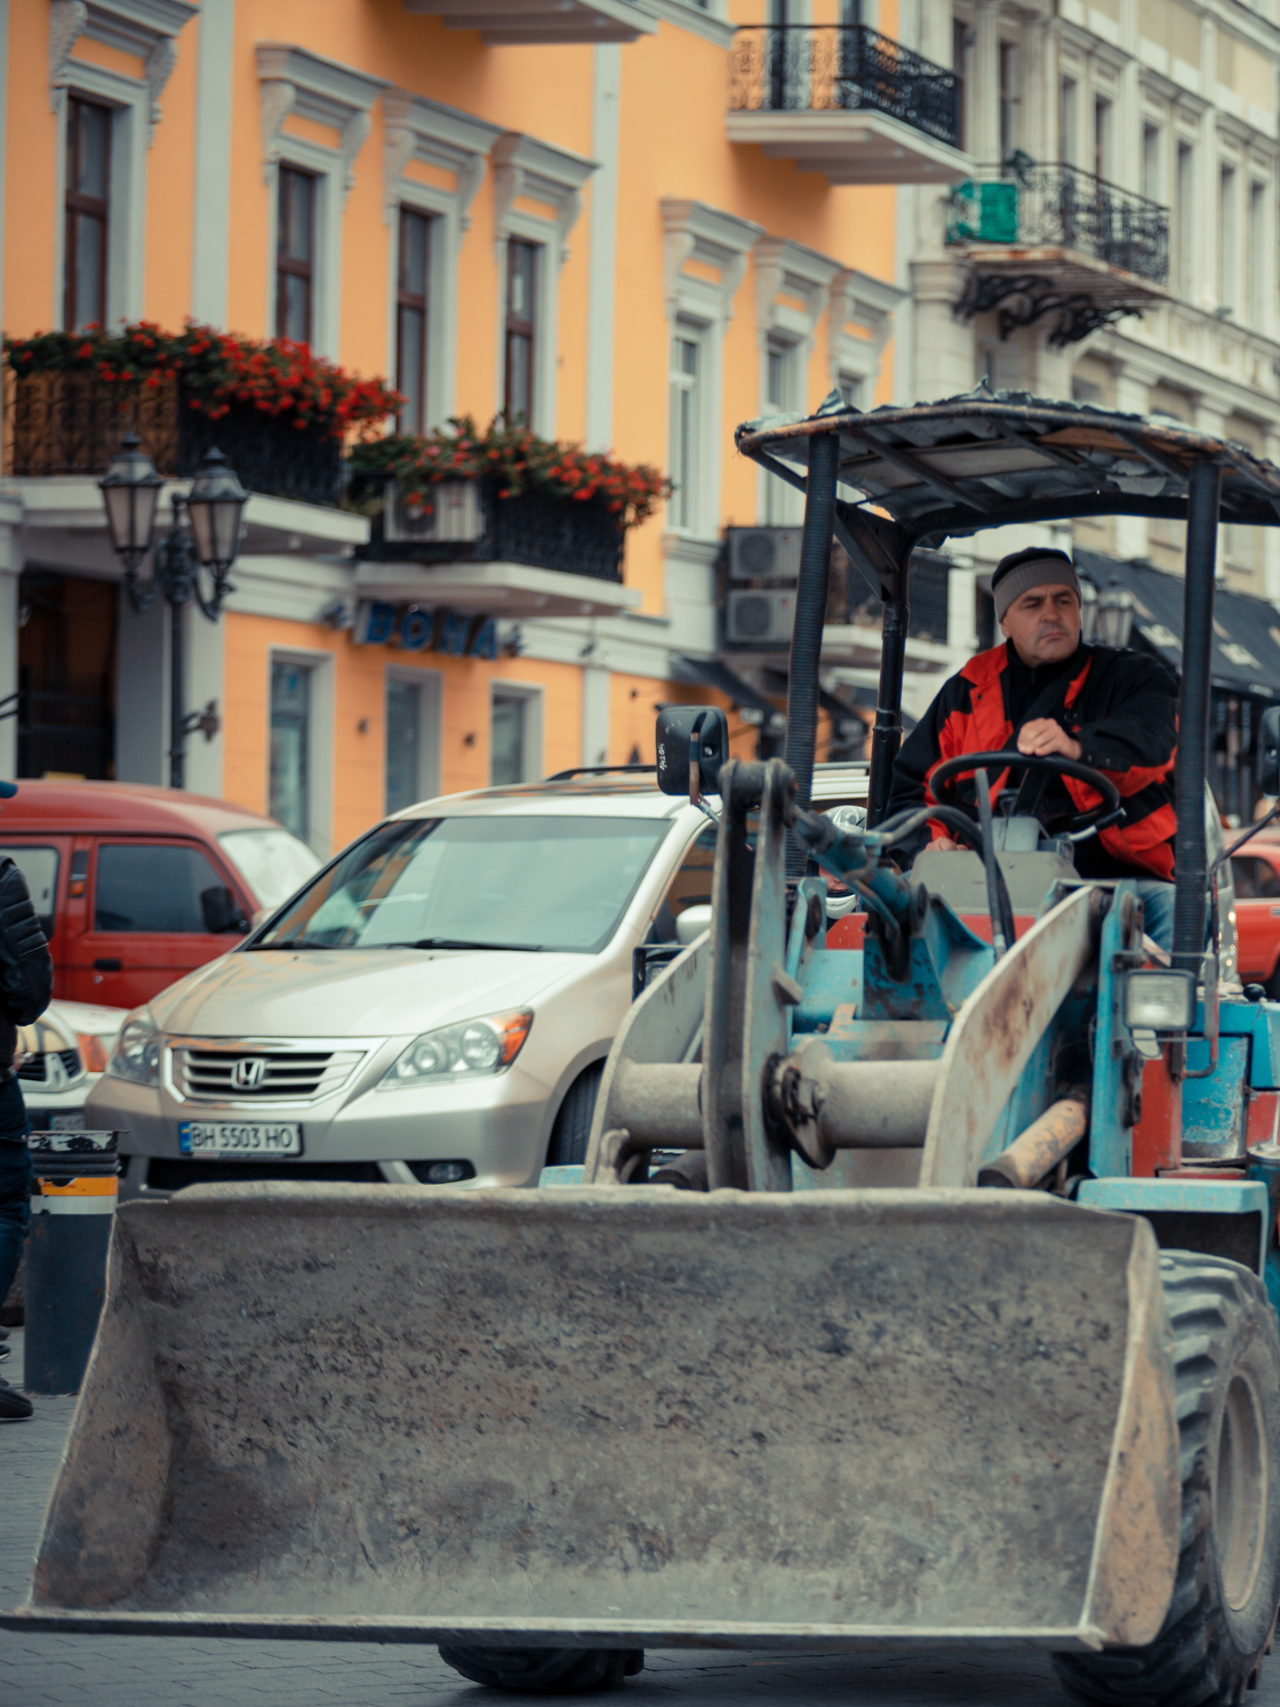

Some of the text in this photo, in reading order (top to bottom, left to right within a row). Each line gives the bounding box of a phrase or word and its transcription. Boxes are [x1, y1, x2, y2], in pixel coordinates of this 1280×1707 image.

[192, 1126, 292, 1148] BH 5503 HO
